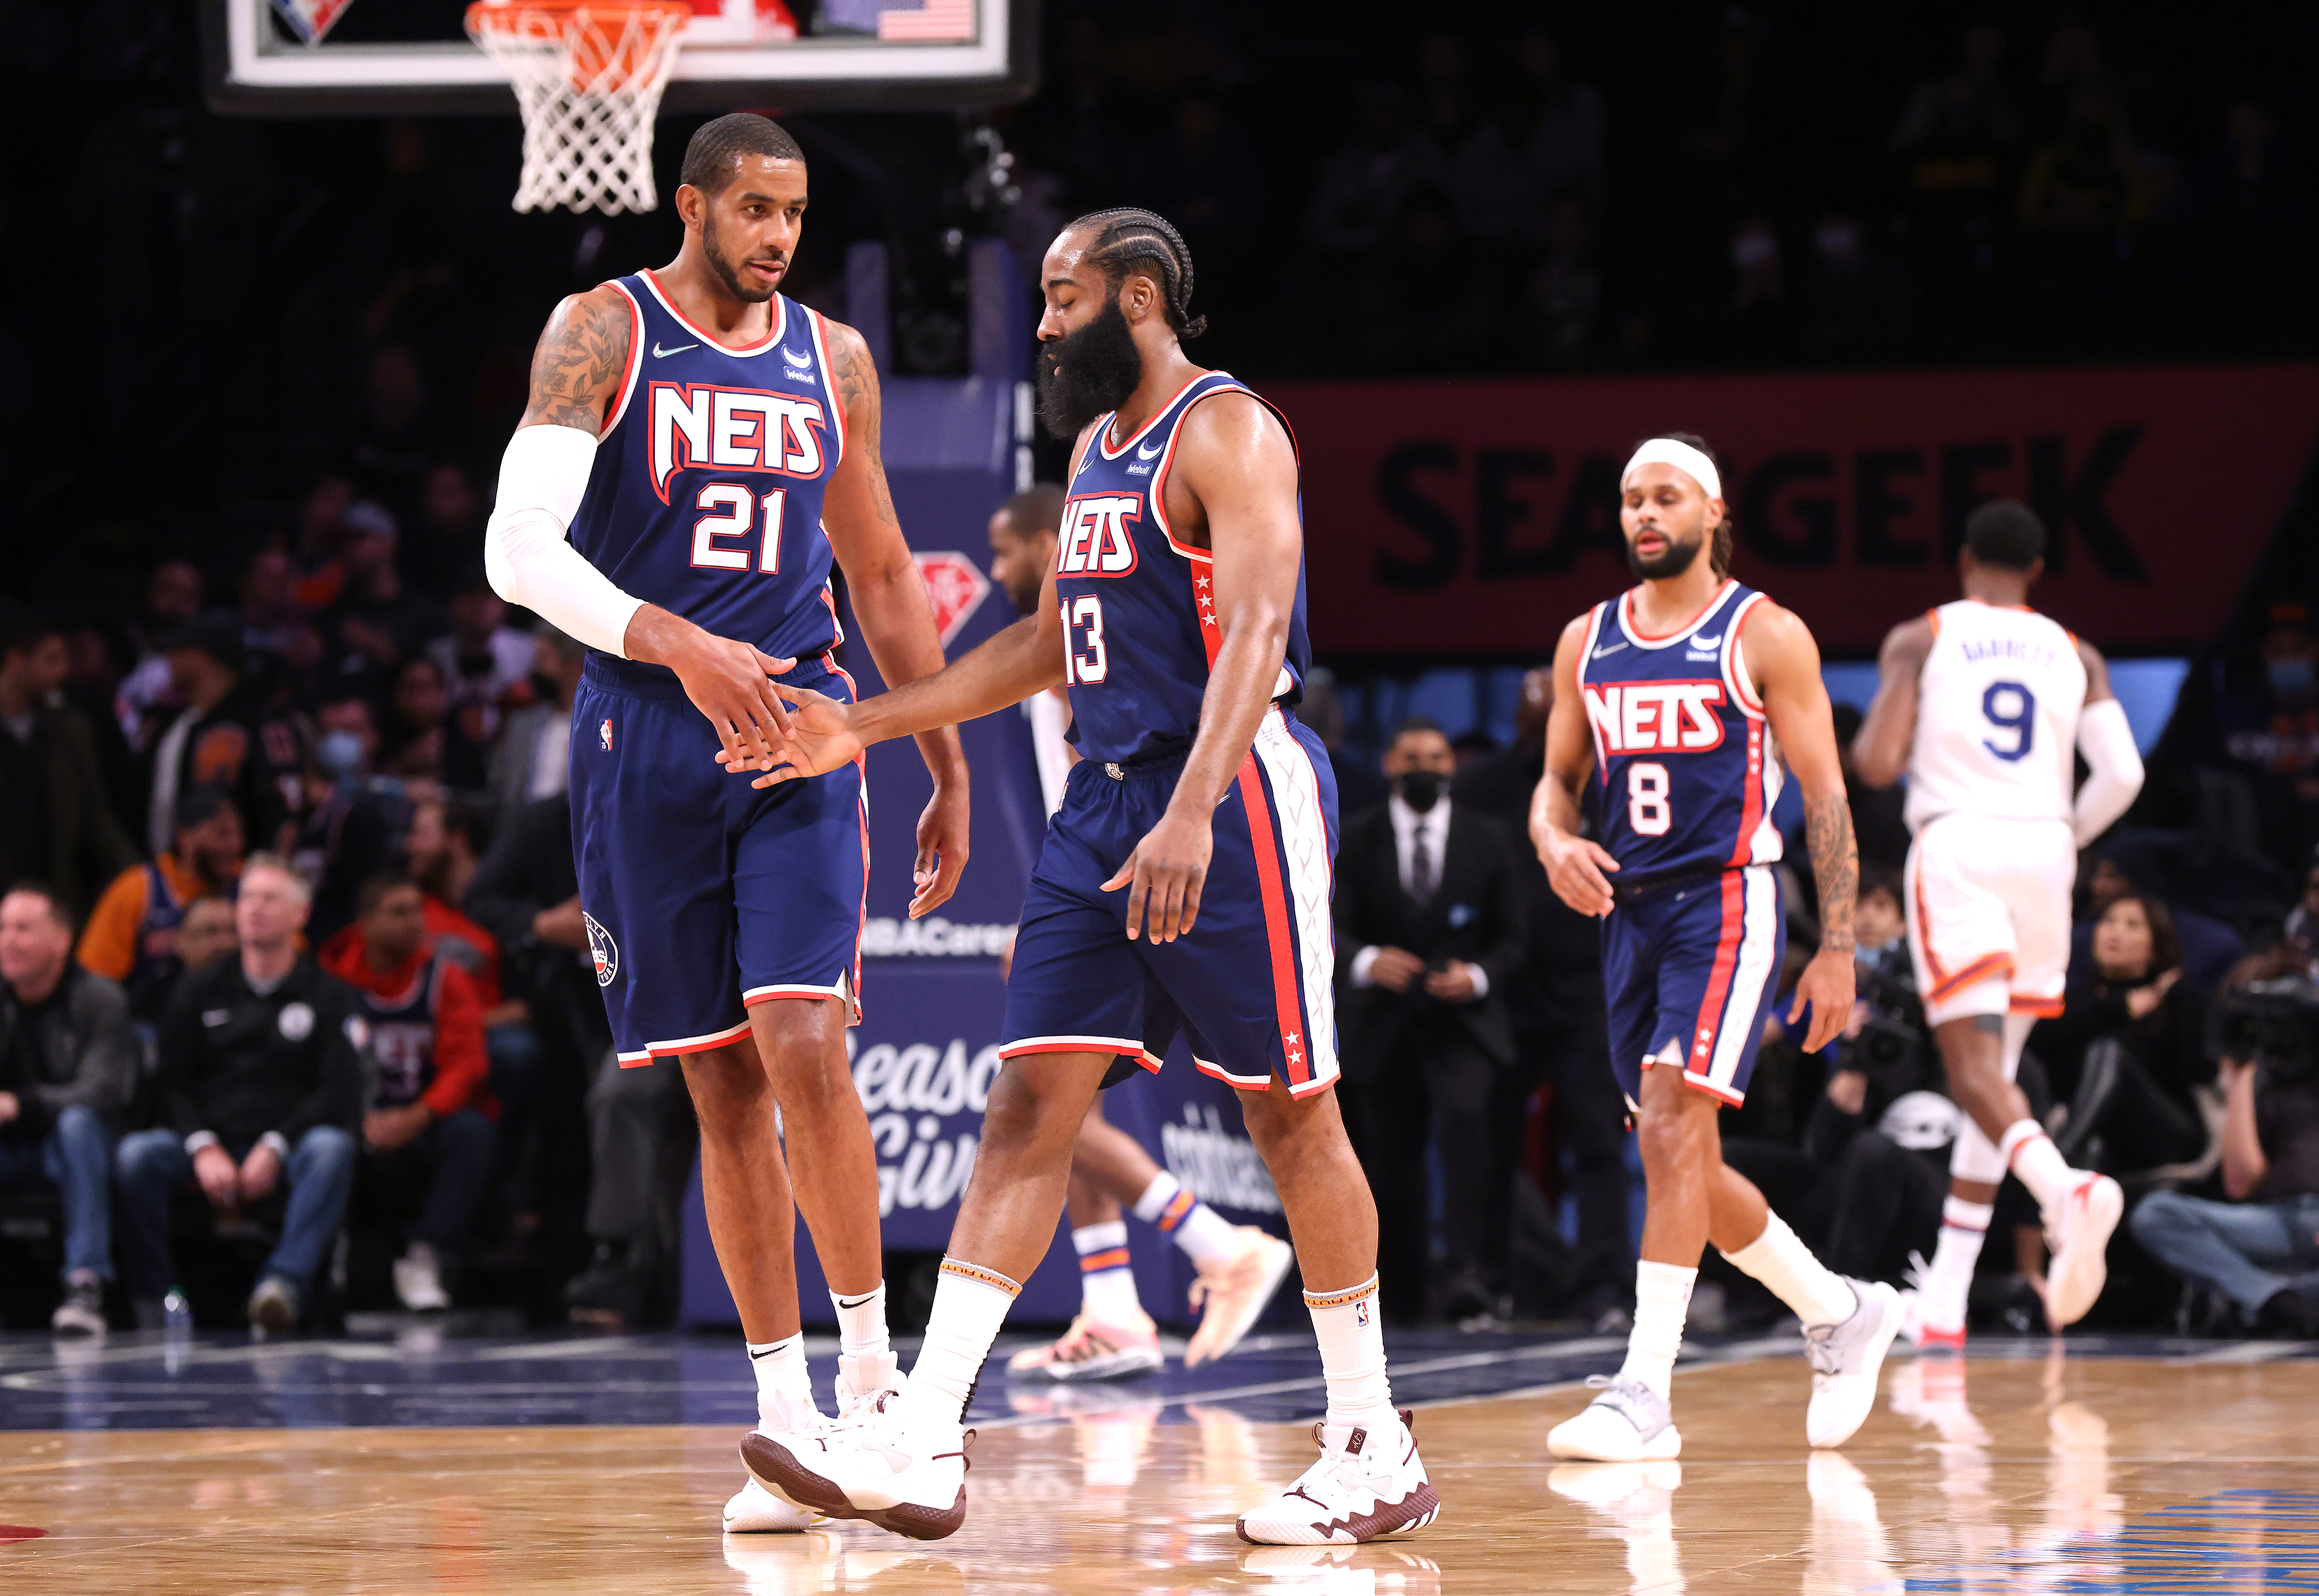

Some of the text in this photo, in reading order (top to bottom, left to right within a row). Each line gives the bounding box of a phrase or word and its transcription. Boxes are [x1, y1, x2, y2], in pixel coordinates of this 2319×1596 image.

[786, 369, 815, 383] Webull
[648, 380, 826, 506] NETS
[1127, 464, 1150, 474] Webull
[690, 482, 787, 574] 21
[1056, 491, 1144, 578] NETS
[1376, 420, 2150, 589] SEAGEEK
[1060, 594, 1108, 687] 13
[1584, 679, 1727, 787] NETS
[1982, 681, 2035, 762] 9
[1627, 761, 1673, 838] 8
[600, 961, 614, 982] YORK
[1349, 1284, 1376, 1301] NBA
